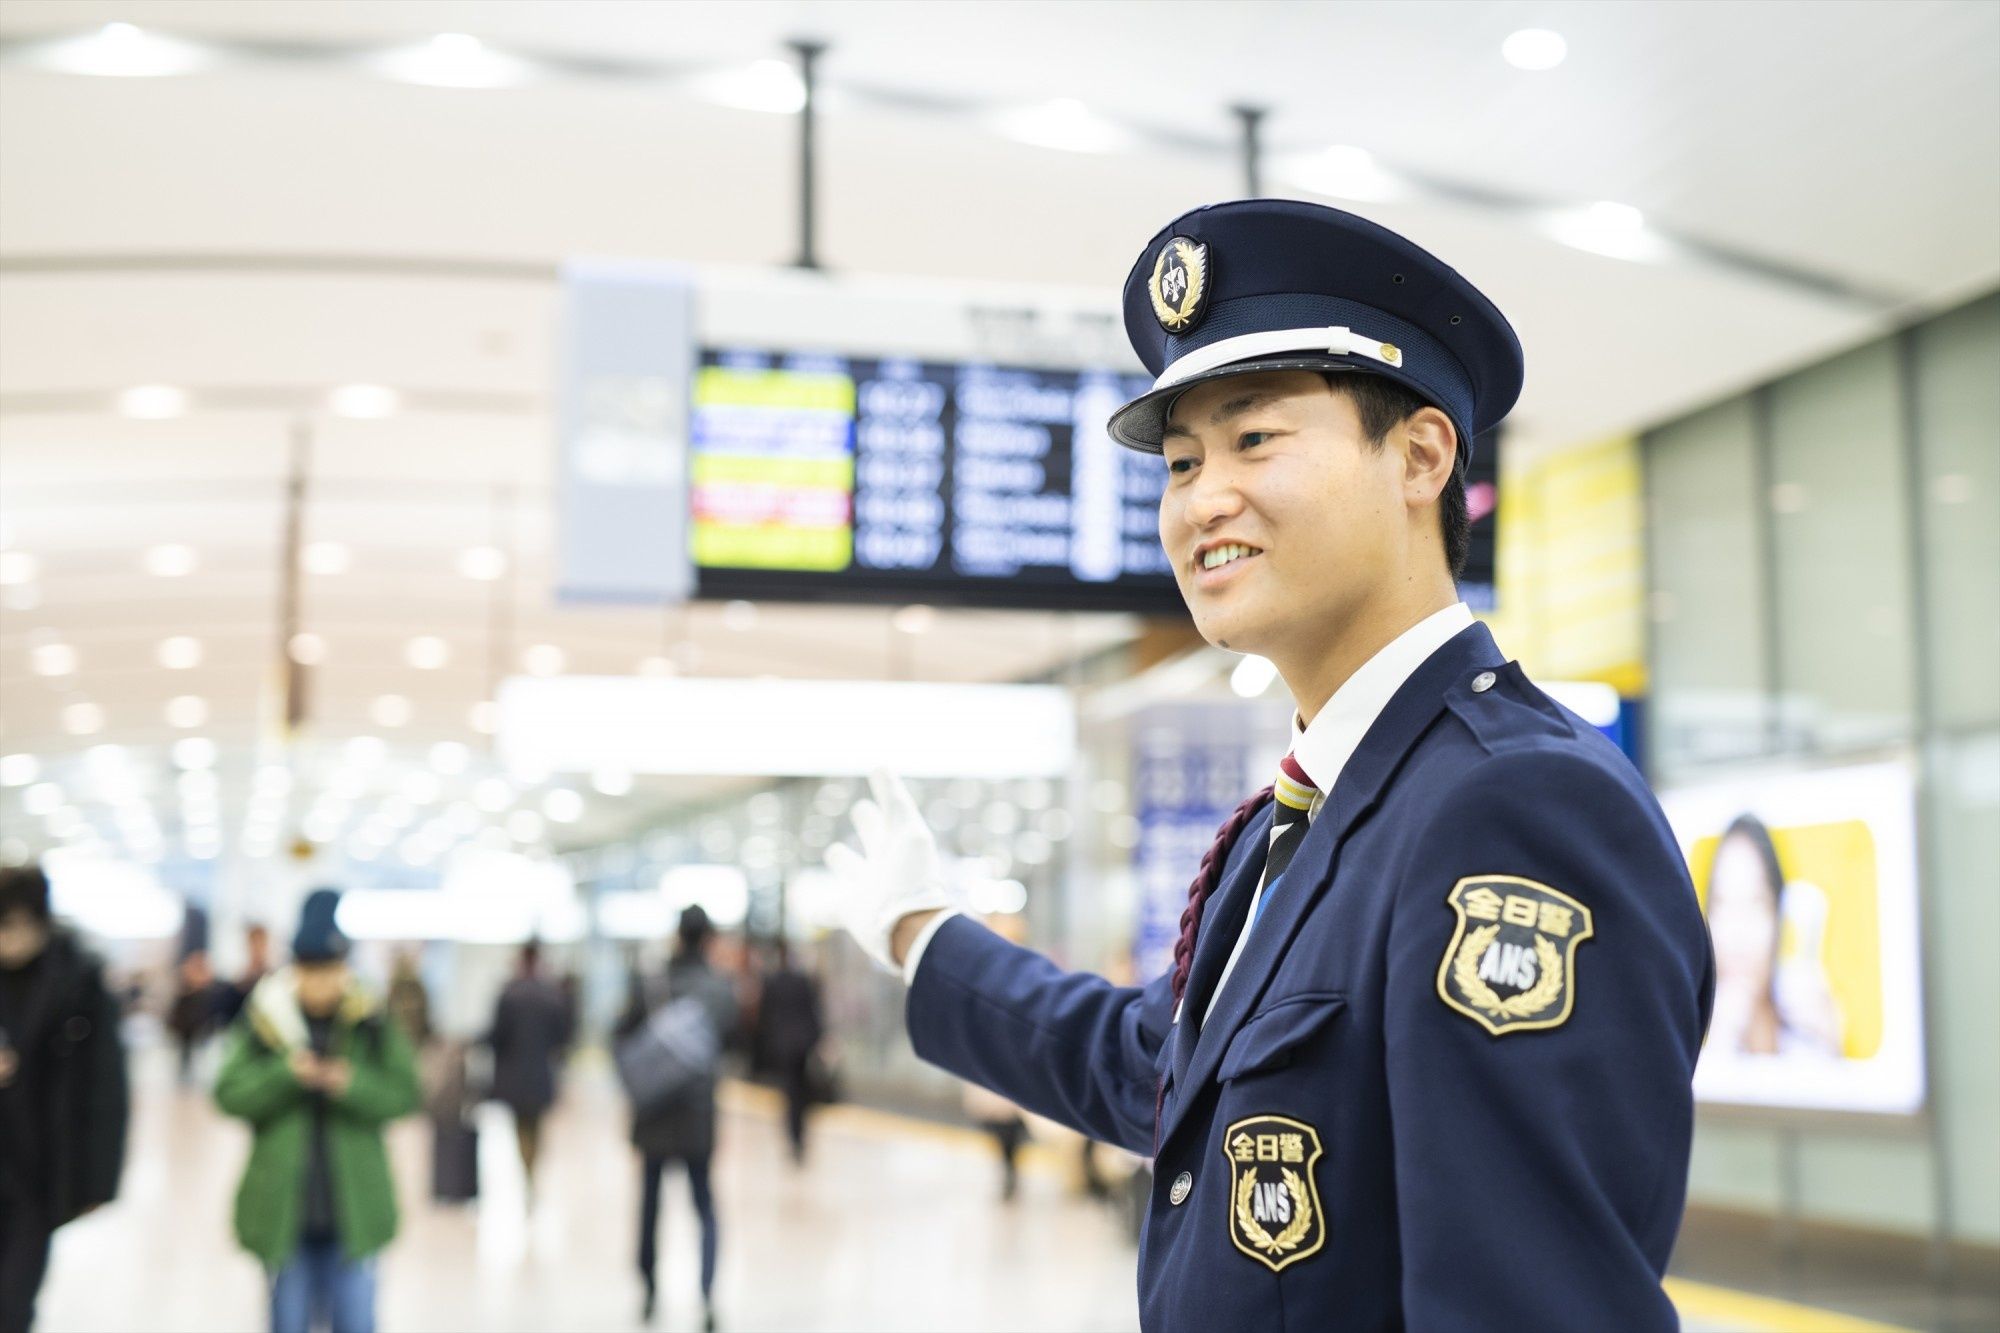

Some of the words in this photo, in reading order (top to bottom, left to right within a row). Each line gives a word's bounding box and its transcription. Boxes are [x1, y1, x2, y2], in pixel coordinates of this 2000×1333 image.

[1464, 887, 1574, 938] 全日警
[1478, 941, 1539, 990] ANS
[1231, 1132, 1304, 1163] 全日警
[1254, 1182, 1290, 1224] ANS
